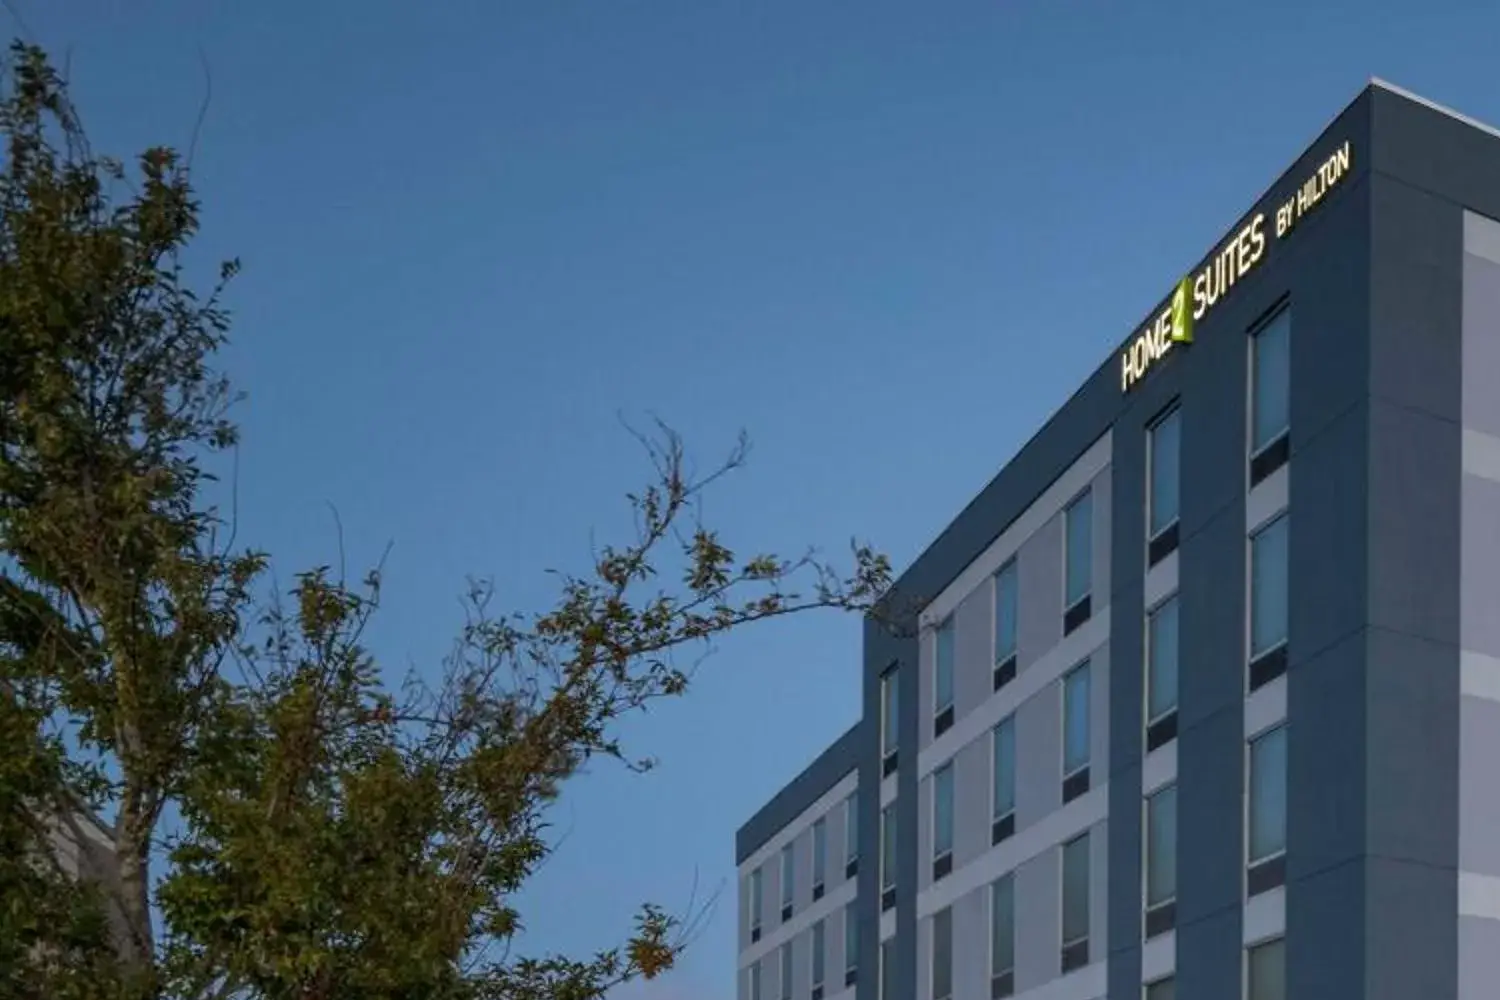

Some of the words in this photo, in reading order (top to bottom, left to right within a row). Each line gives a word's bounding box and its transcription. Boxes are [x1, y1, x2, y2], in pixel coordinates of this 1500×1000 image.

[1193, 213, 1265, 320] SUITES
[1276, 196, 1295, 239] BY
[1297, 141, 1350, 217] HILTON
